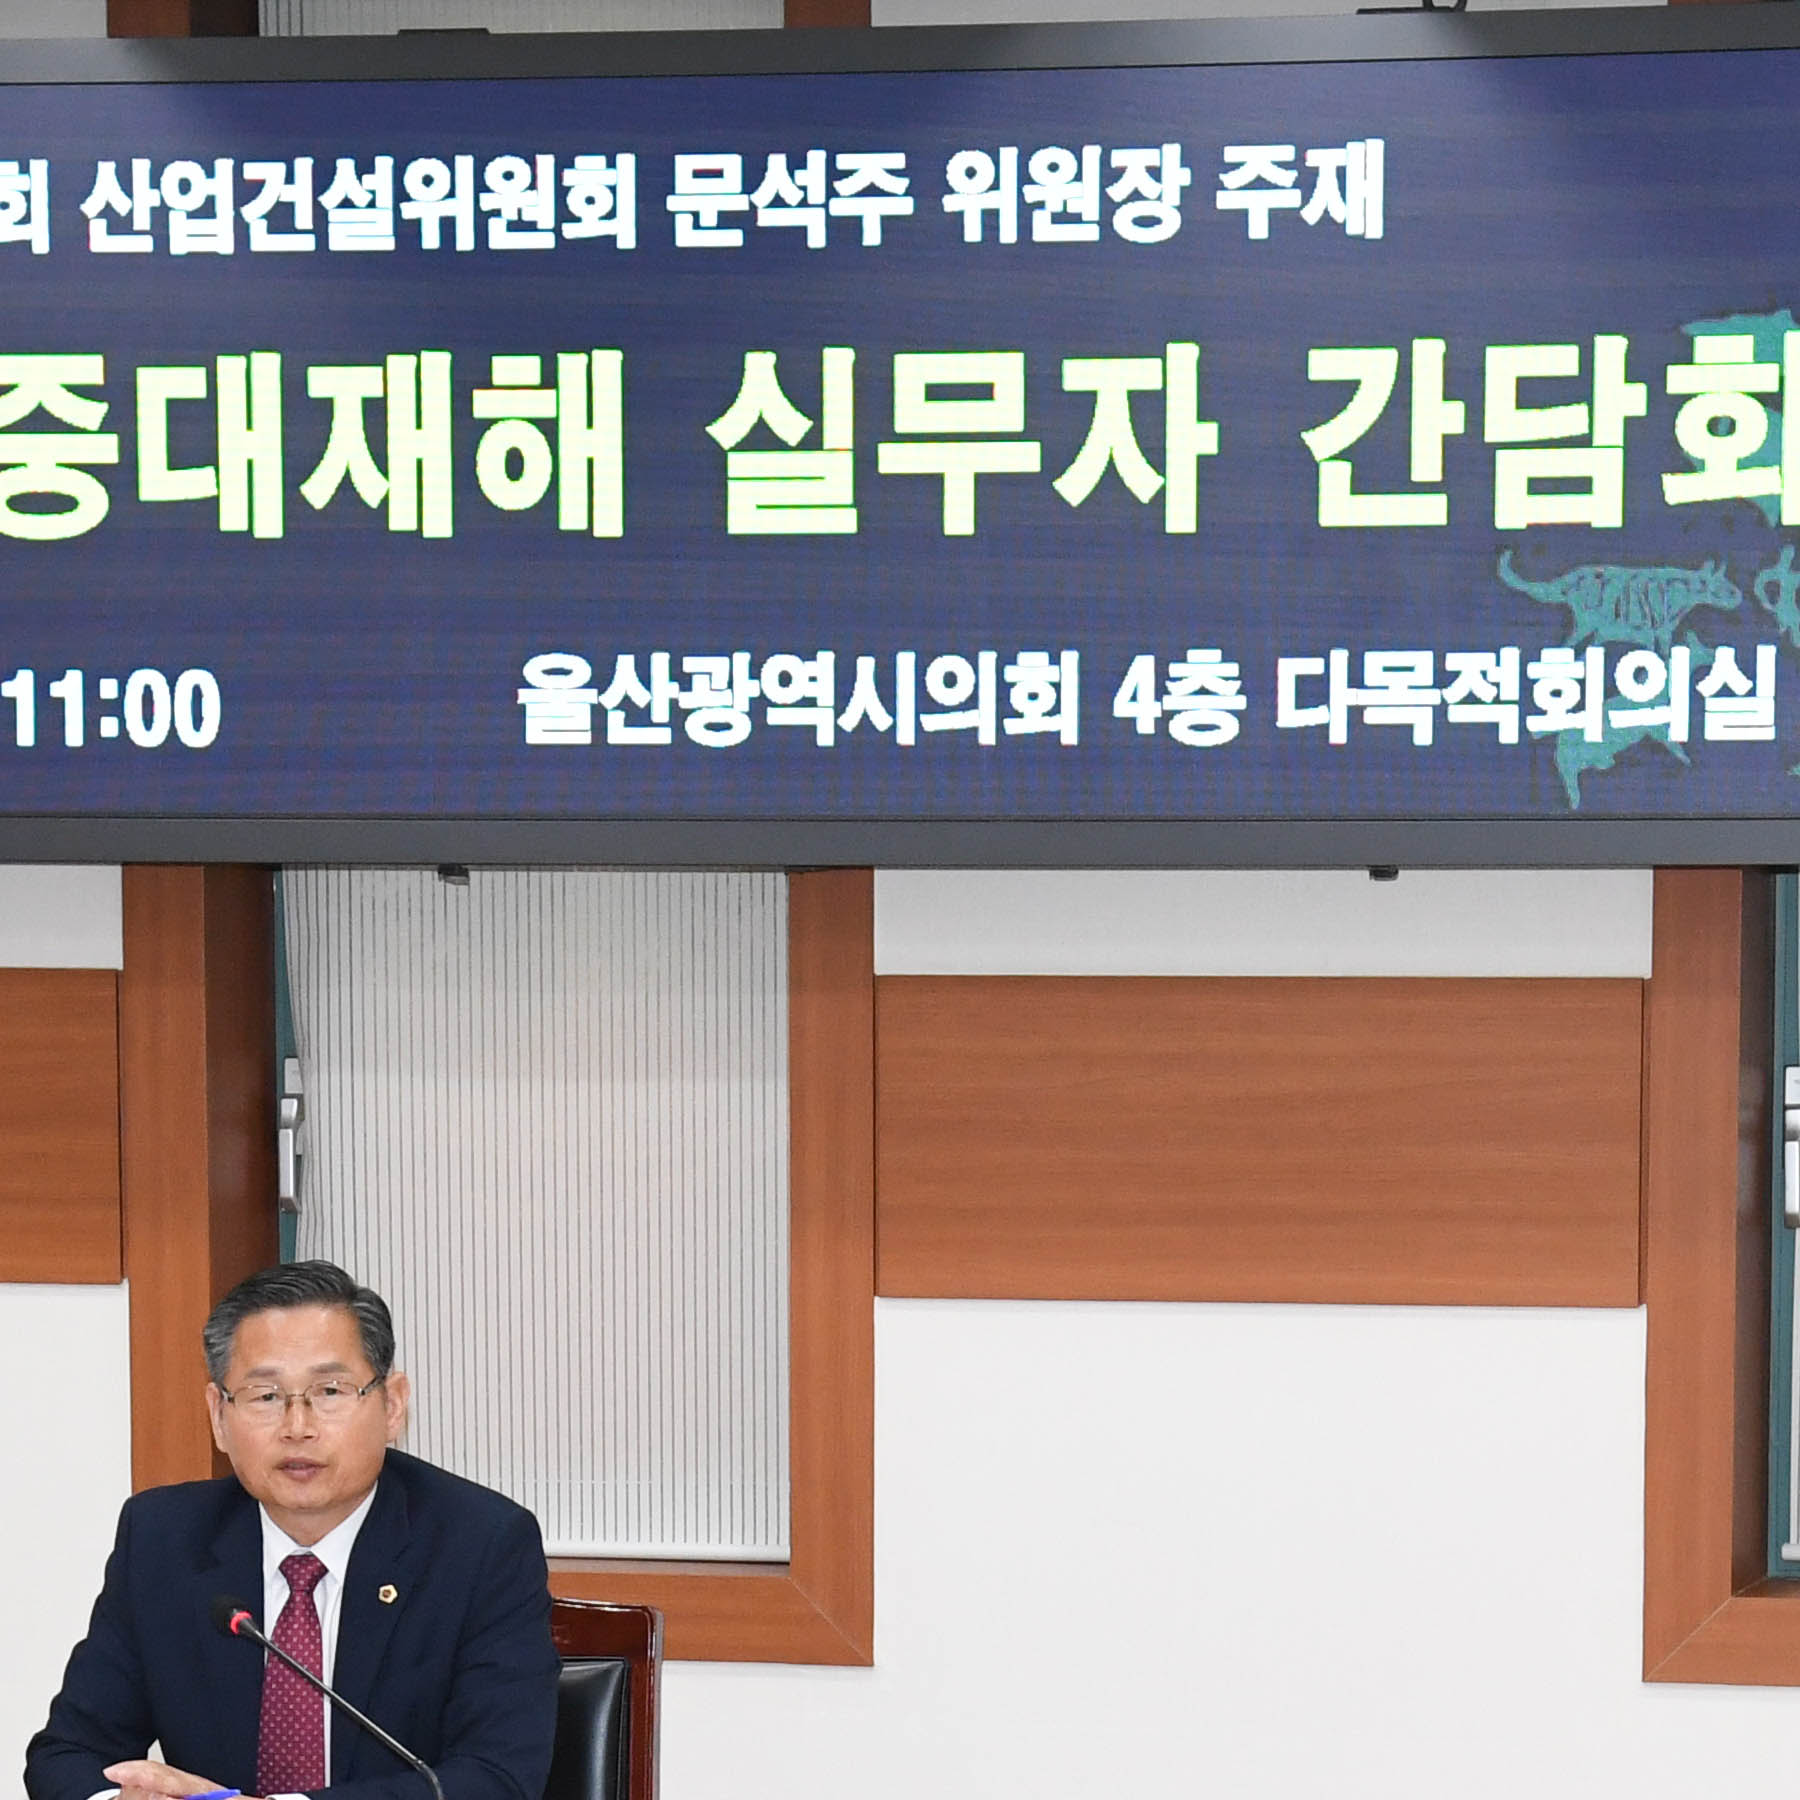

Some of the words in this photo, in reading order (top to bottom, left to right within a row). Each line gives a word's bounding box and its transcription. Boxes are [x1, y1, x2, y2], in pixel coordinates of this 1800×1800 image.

[79, 152, 637, 256] 산업건설위원회
[665, 148, 915, 250] 문석주
[940, 142, 1193, 245] 위원장
[1214, 137, 1386, 241] 주재
[704, 341, 1219, 537] 실무자
[0, 668, 222, 749] 11:00
[515, 649, 1080, 748] 울산광역시의회
[1112, 648, 1248, 748] 4층
[1274, 643, 1778, 747] 다목적회의실
